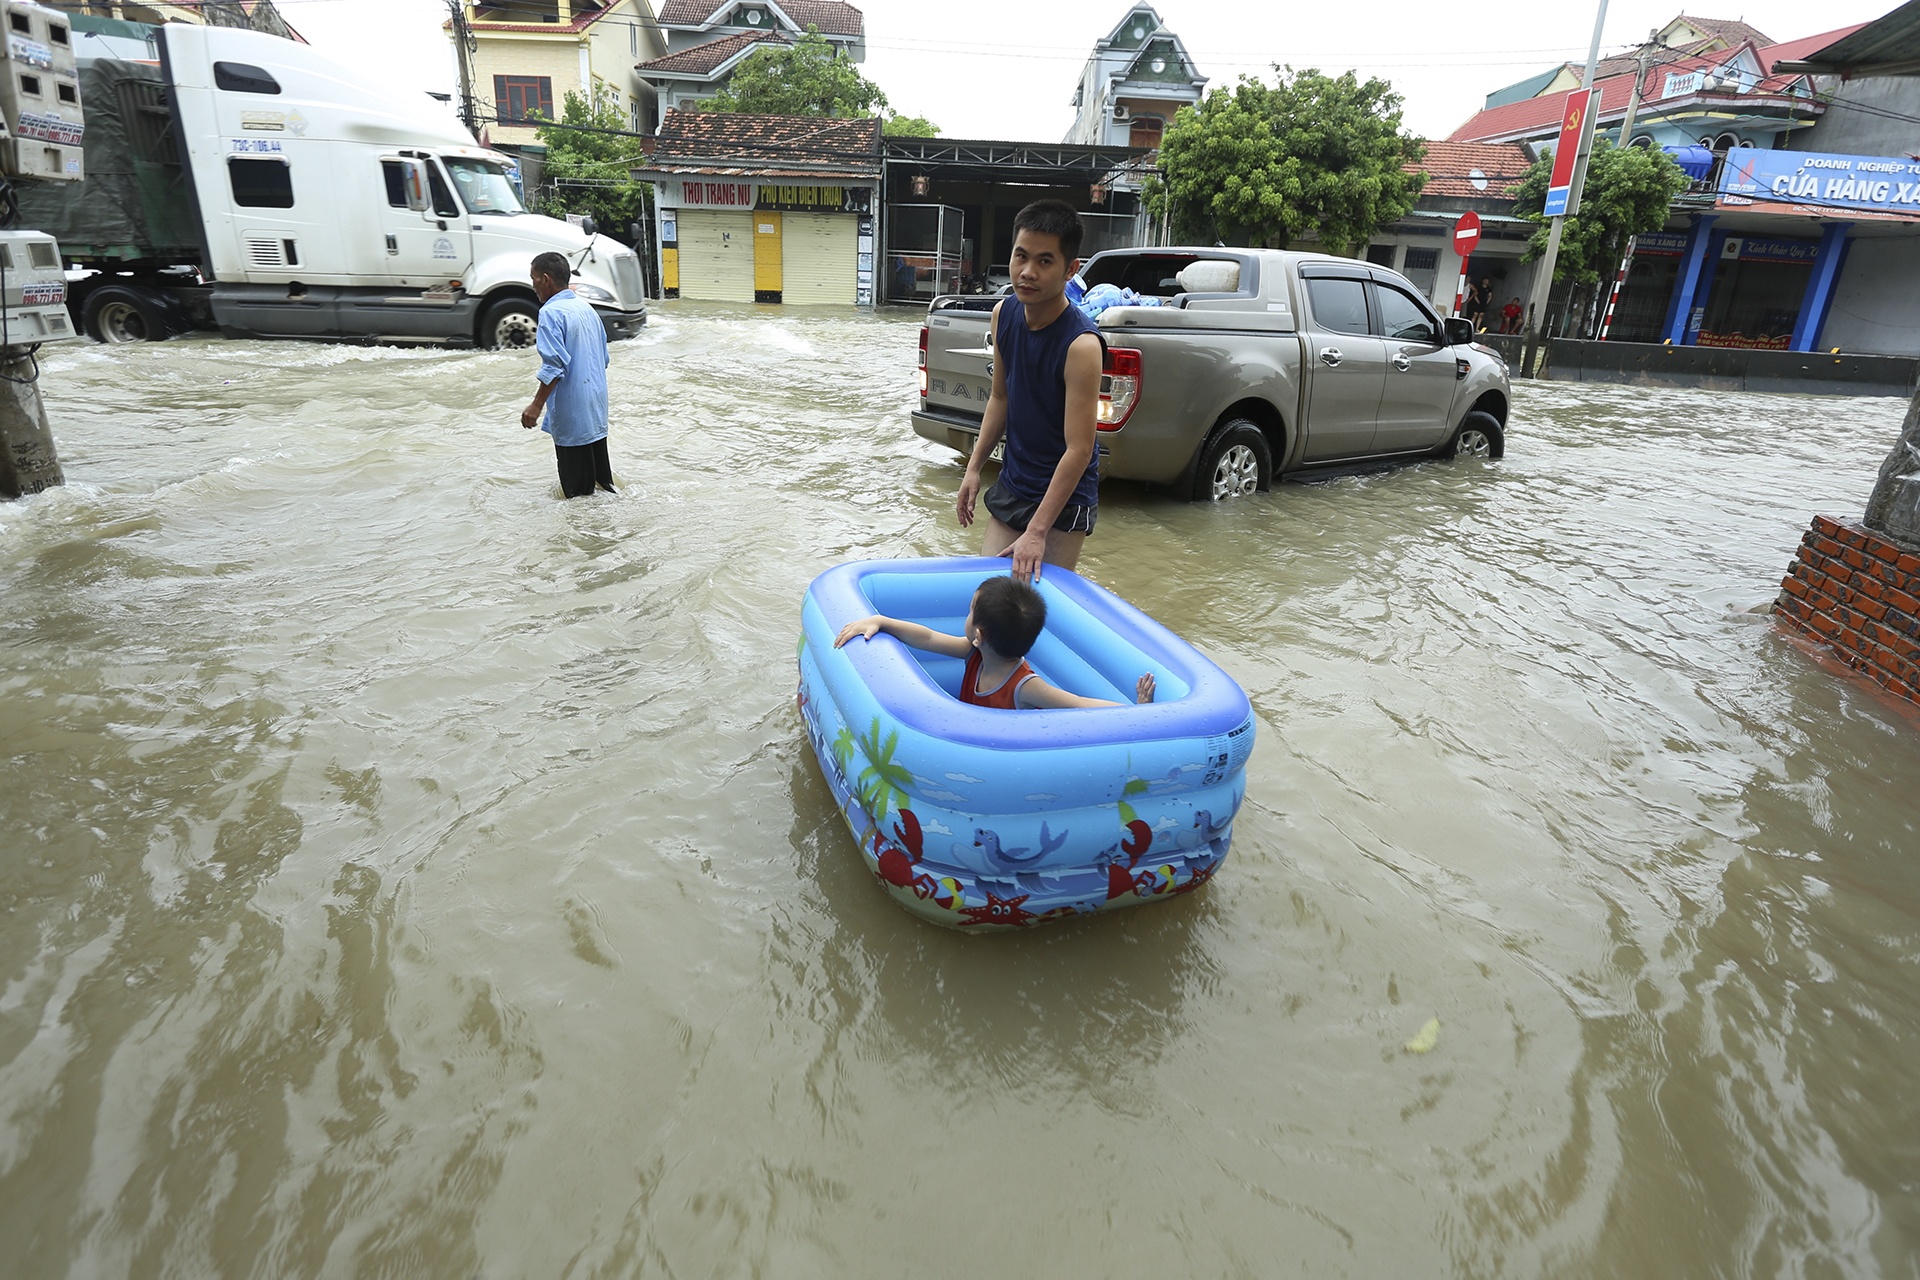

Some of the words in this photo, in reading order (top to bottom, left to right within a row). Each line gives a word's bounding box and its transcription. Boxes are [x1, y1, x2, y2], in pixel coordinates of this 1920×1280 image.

[1804, 158, 1852, 171] DOANH
[1856, 161, 1906, 176] NGHIỆP
[705, 183, 736, 206] TRANG
[1772, 167, 1820, 199] CỬA
[1823, 174, 1890, 203] HÀNG
